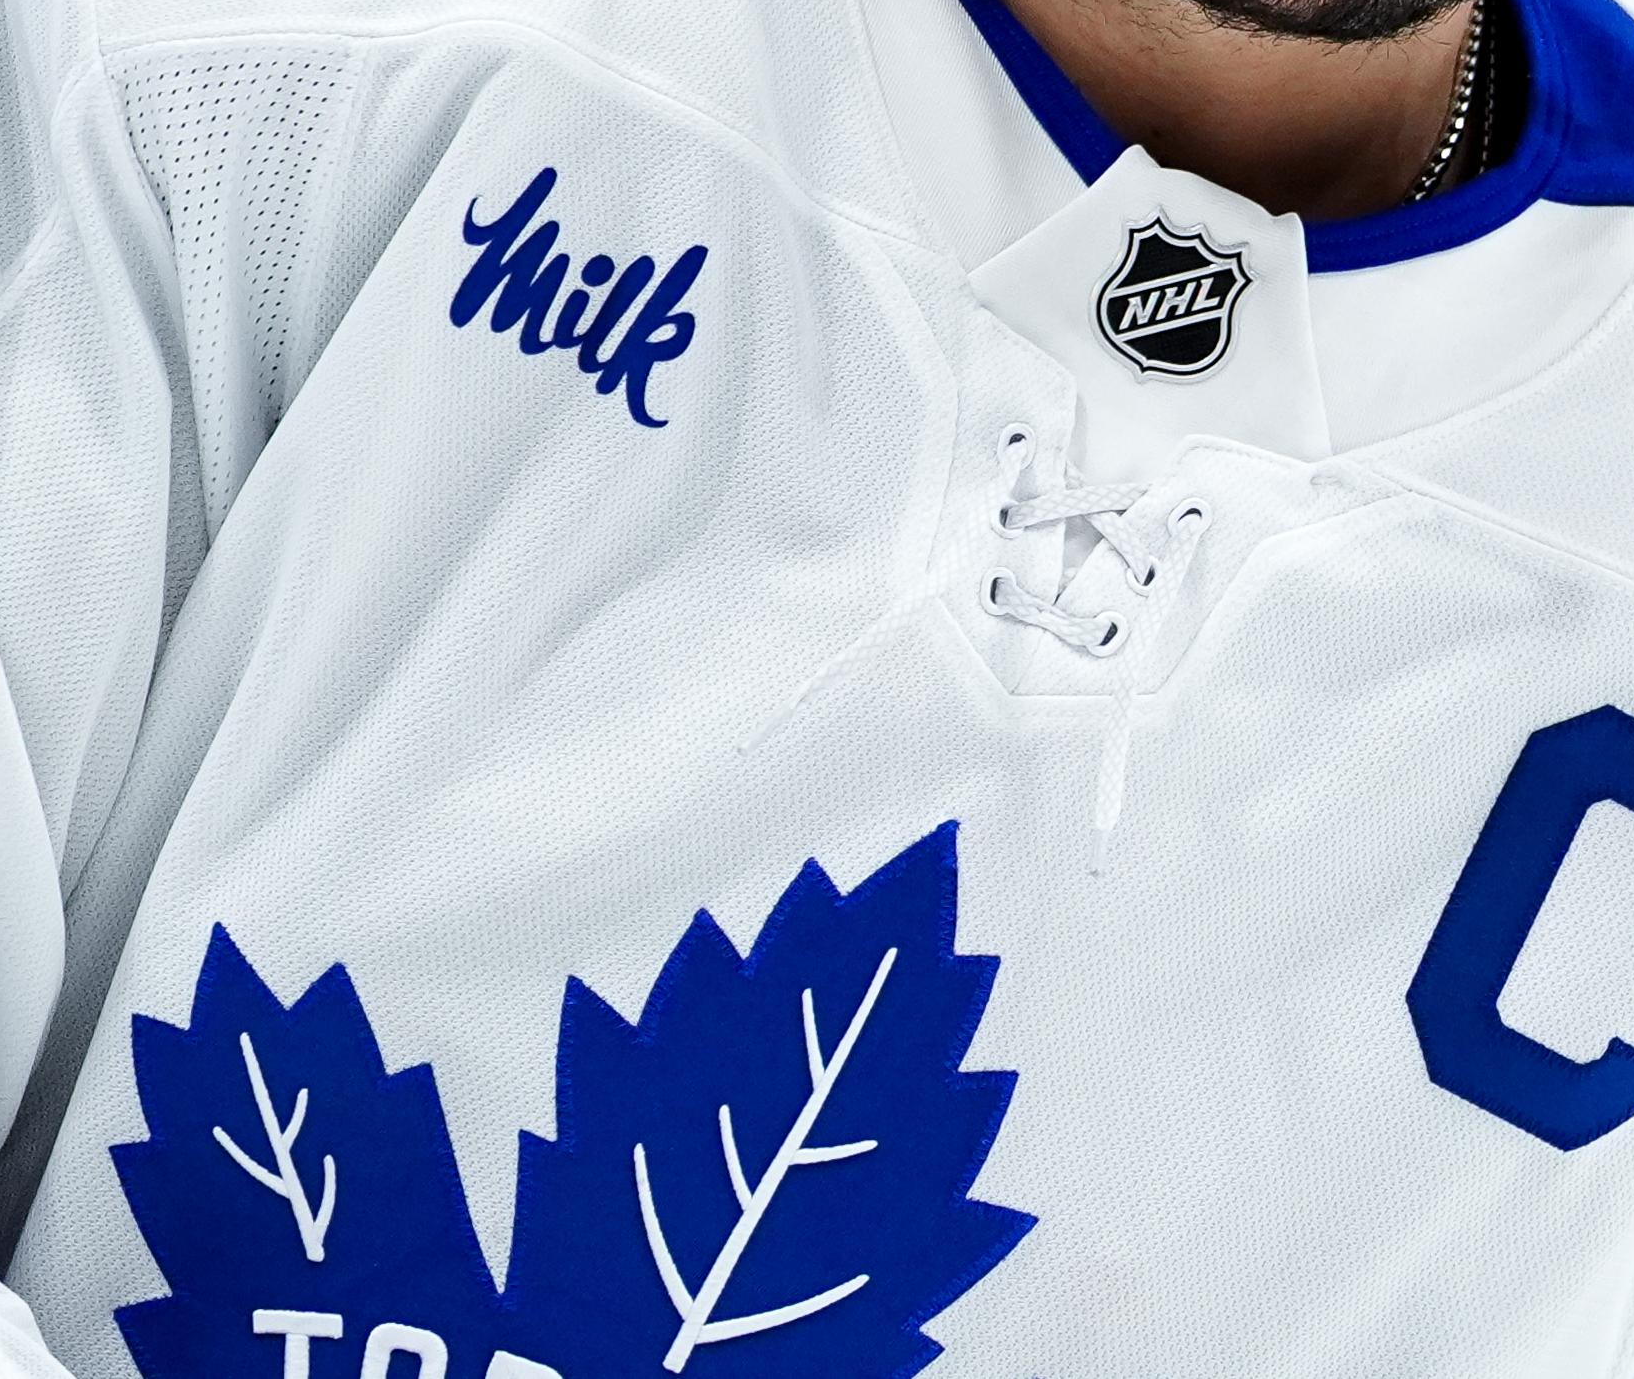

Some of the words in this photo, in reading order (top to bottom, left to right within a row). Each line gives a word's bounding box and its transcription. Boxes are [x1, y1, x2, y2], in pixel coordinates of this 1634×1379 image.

[449, 167, 709, 429] Milk
[1118, 276, 1222, 331] NHL
[252, 1308, 565, 1379] TO
